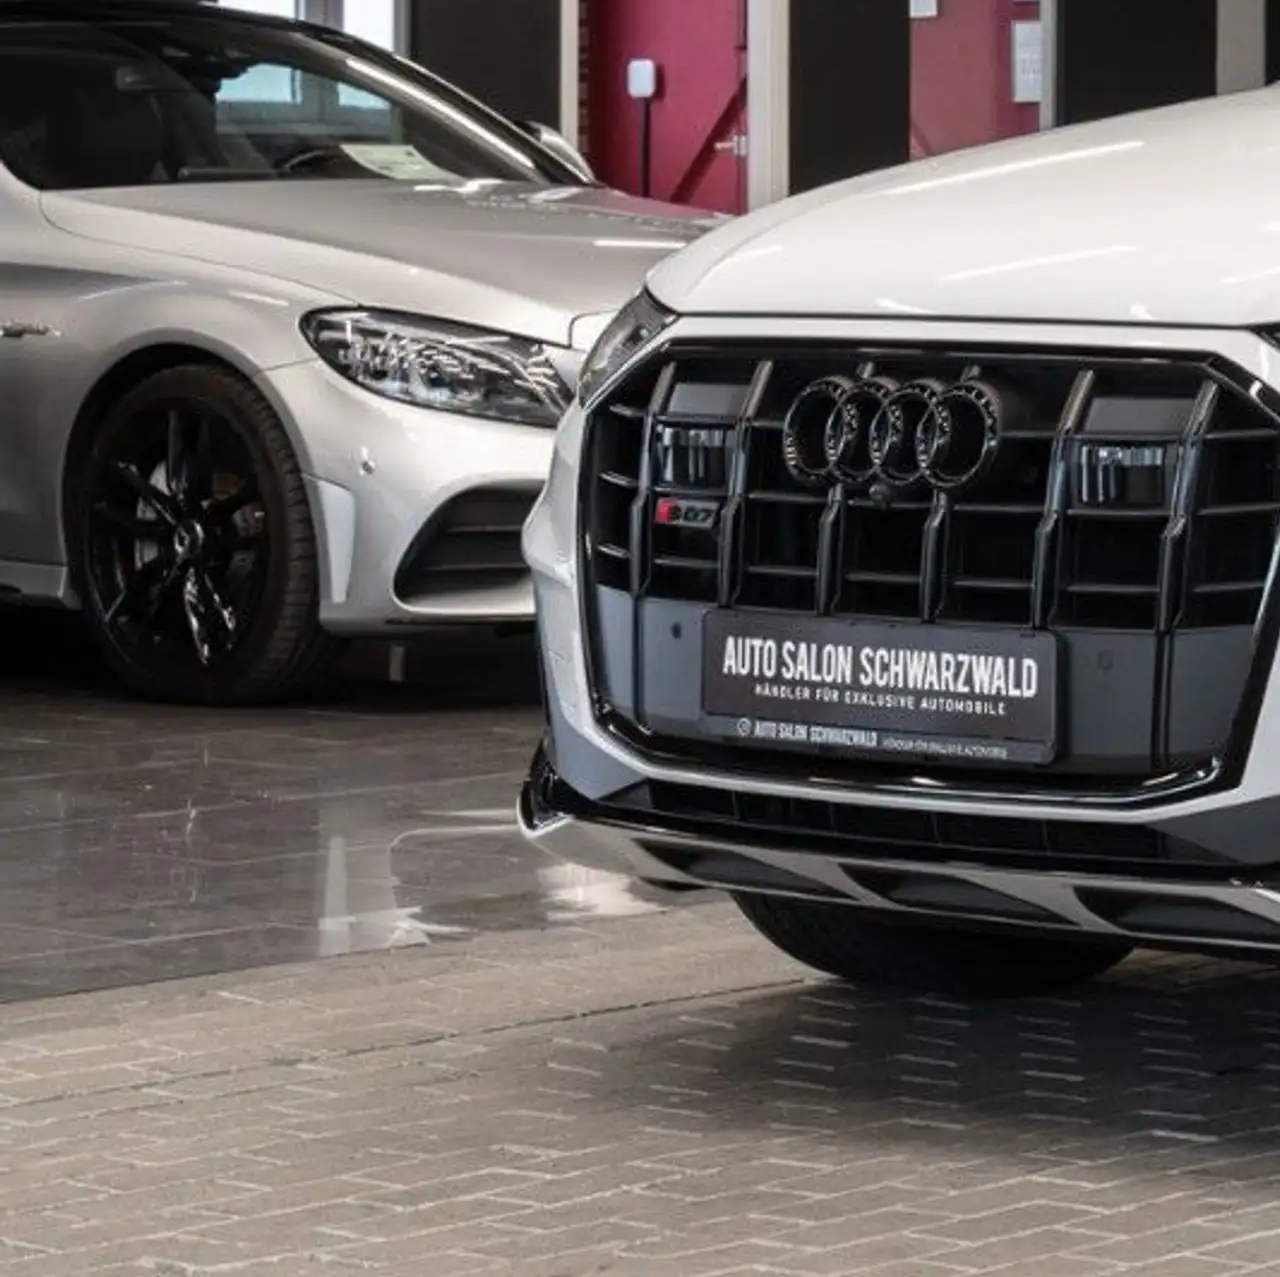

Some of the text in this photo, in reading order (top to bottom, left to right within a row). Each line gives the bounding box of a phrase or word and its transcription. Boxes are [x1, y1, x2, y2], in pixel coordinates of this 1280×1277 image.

[722, 635, 1038, 699] AUTO SALON SCHWARZWALD
[815, 687, 840, 703] FÜR
[919, 695, 1006, 716] AUTOMOBILE
